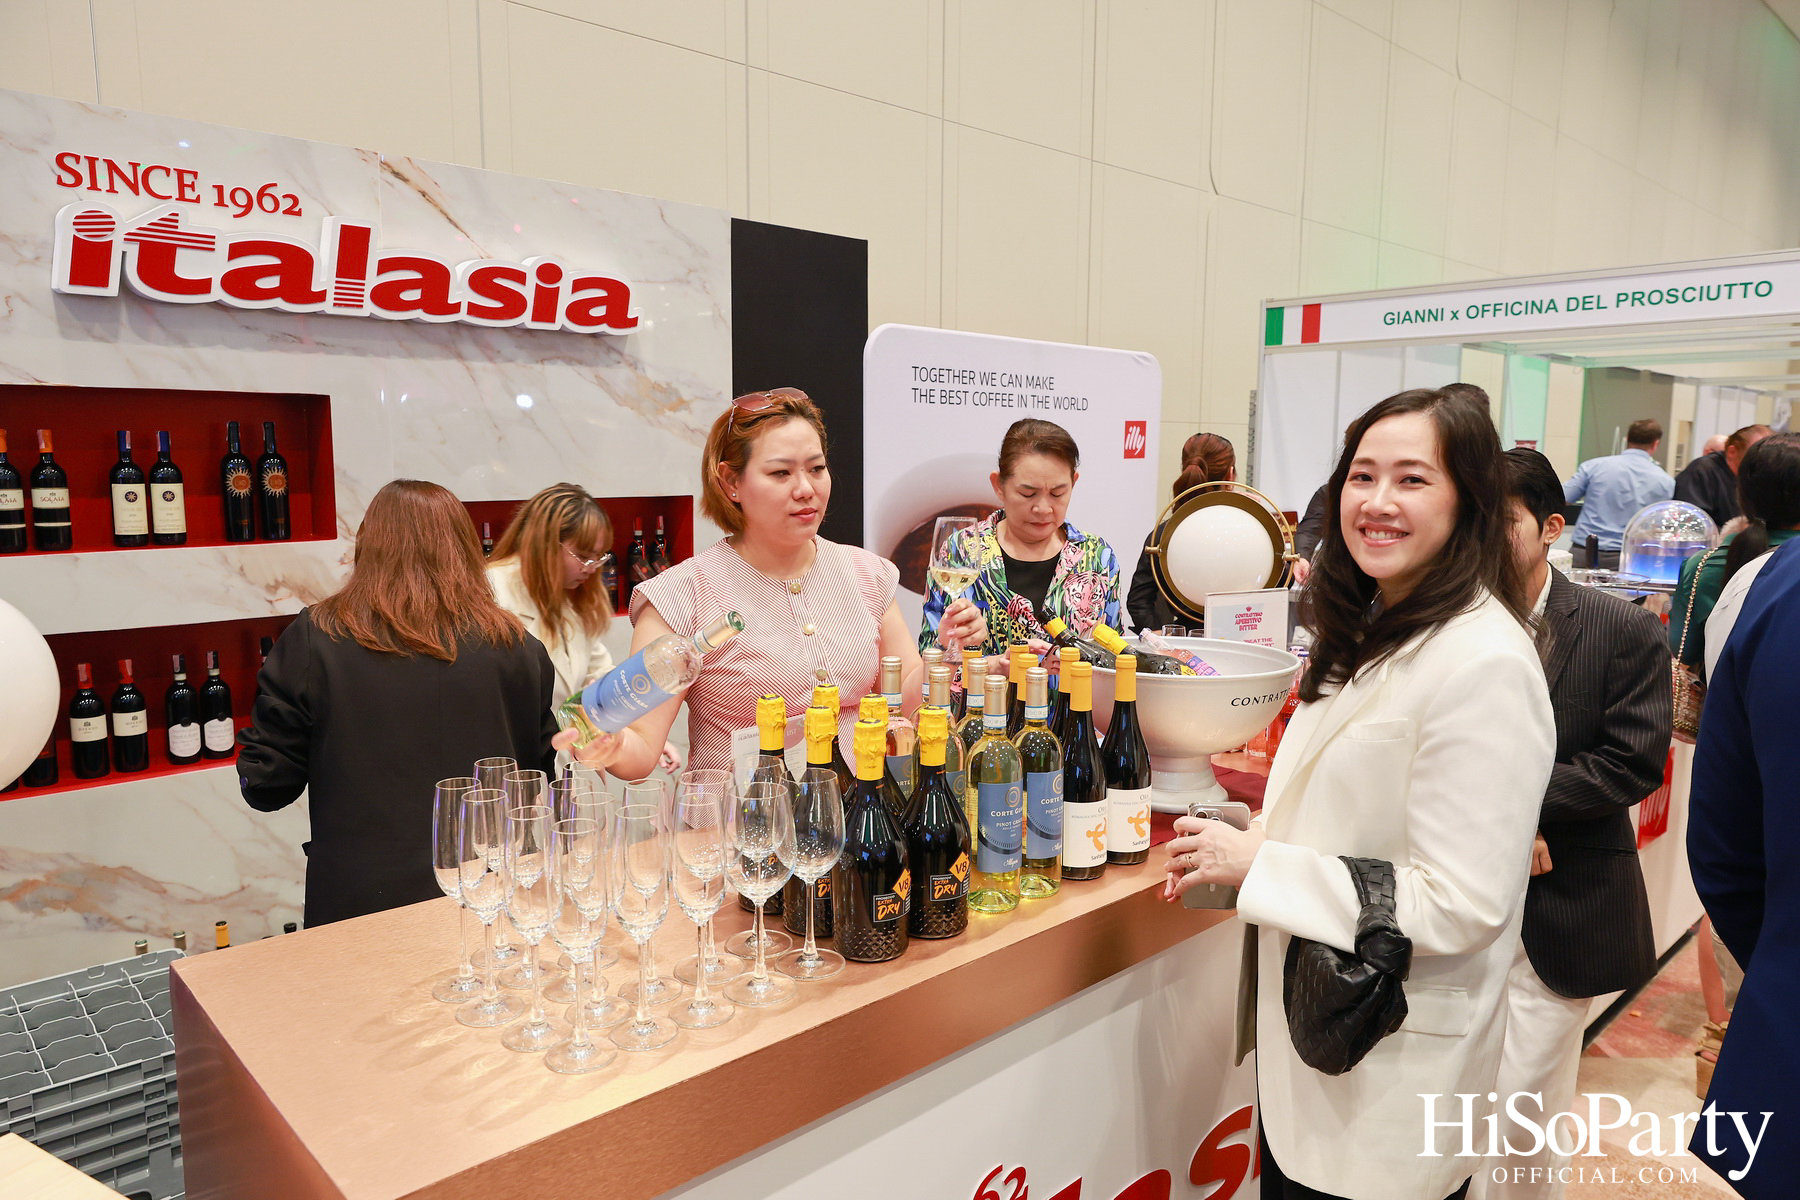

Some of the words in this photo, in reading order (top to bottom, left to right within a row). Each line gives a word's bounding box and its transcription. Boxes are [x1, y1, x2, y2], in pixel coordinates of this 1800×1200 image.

[55, 151, 201, 204] SINCE
[212, 182, 302, 219] 1962
[67, 208, 640, 331] italasia
[1383, 308, 1445, 326] GIANNI
[1450, 309, 1460, 321] x
[1466, 299, 1559, 320] OFFICINA
[1566, 295, 1608, 312] DEL
[1616, 280, 1774, 308] PROSCIUTTO
[912, 366, 976, 385] TOGETHER
[979, 371, 997, 387] WE
[1000, 372, 1023, 389] CAN
[1025, 376, 1055, 391] MAKE
[911, 387, 936, 404] THE
[939, 389, 970, 406] BEST
[972, 391, 1014, 408] COFFEE
[1017, 394, 1028, 408] IN
[1031, 395, 1050, 409] THE
[1053, 396, 1089, 411] WORLD
[1125, 425, 1145, 456] illy
[620, 669, 631, 692] CORTE
[1040, 796, 1060, 805] CORTE
[955, 861, 967, 875] V8
[898, 877, 909, 893] V8
[934, 882, 958, 900] DRY
[877, 901, 901, 921] DRY
